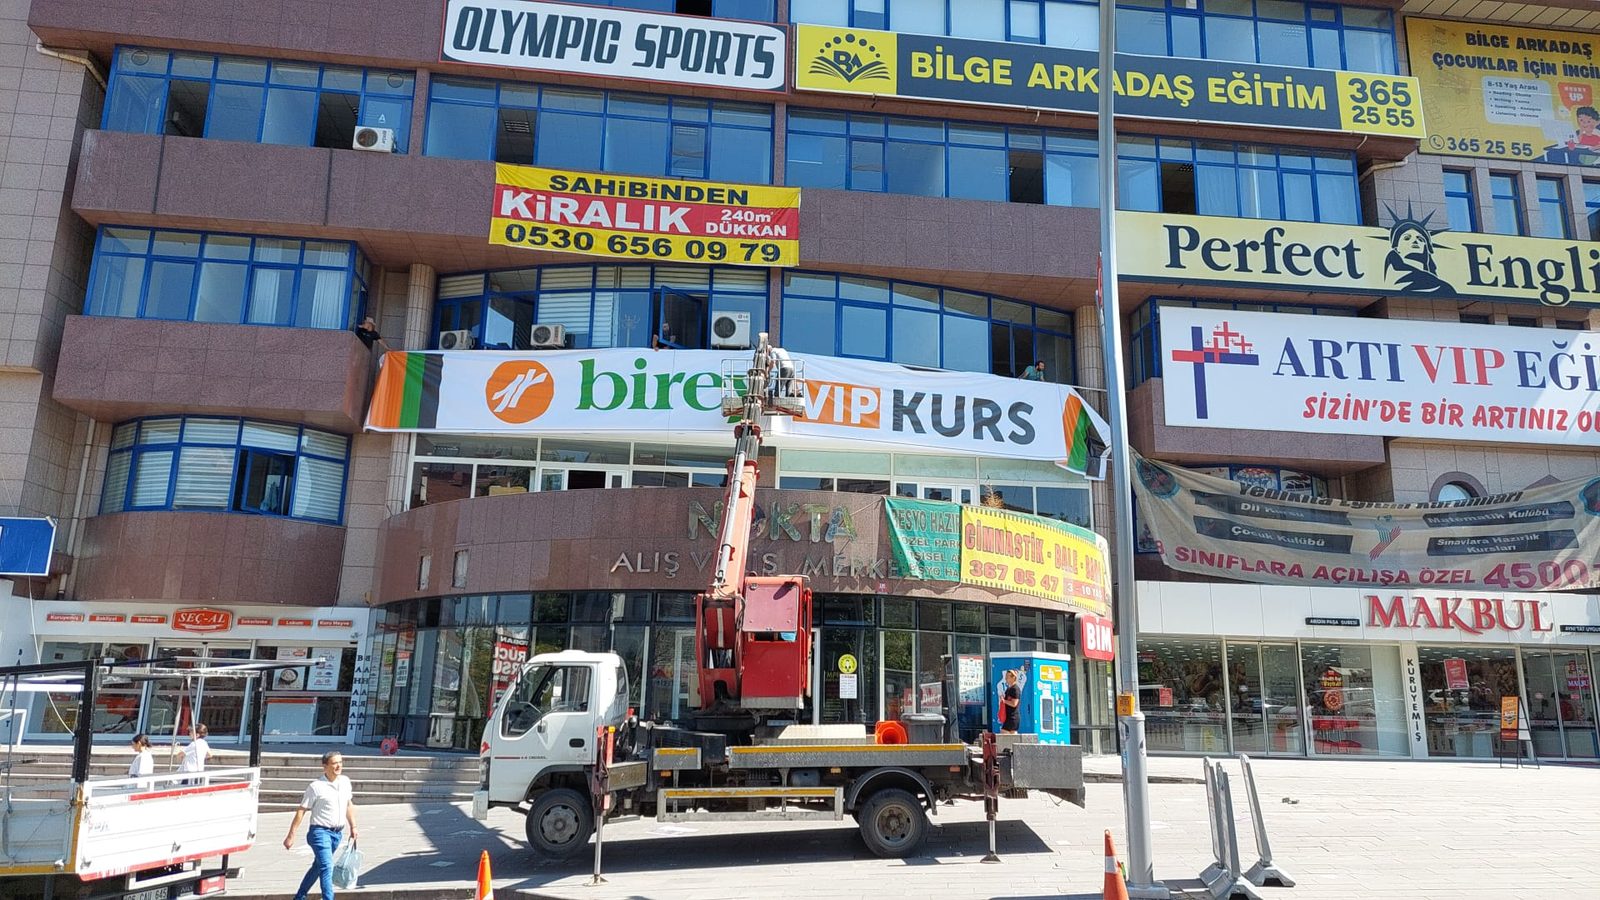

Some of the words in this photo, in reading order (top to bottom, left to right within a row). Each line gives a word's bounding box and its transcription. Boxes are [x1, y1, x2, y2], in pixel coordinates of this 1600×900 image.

[452, 5, 622, 64] OLYMPIC
[632, 23, 778, 78] SPORTS
[1465, 30, 1510, 49] BİLGE
[1516, 37, 1592, 60] ARKADAŞ
[911, 46, 1013, 86] BİLGE
[1027, 62, 1195, 108] ARKADAŞ
[1207, 71, 1327, 111] EĞİTİM
[1432, 52, 1518, 73] ÇOCUKLAR
[1523, 57, 1557, 78] İÇİN
[1348, 77, 1412, 107] 365
[1351, 105, 1381, 124] 25
[1386, 108, 1416, 128] 55
[1447, 137, 1480, 152] 365
[1485, 140, 1506, 154] 25
[1511, 142, 1533, 157] 55
[505, 223, 595, 252] 0530
[607, 233, 673, 259] 656
[685, 239, 728, 261] 09
[739, 242, 782, 263] 79
[706, 220, 787, 237] DÜKKAN
[1163, 223, 1365, 280] Perfect
[1273, 336, 1406, 382] ARTI
[1411, 344, 1506, 387] VIP
[1513, 340, 1600, 392] EĞİ
[803, 383, 880, 425] VIP
[891, 389, 1036, 446] KURS
[1302, 391, 1411, 424] SİZİN'DE
[1420, 398, 1464, 430] BİR
[1471, 405, 1570, 433] ARTINIZ
[1508, 508, 1550, 519] Kulübü
[964, 519, 1045, 565] GİMNASTİK
[1055, 543, 1078, 575] BALE
[1231, 525, 1273, 541] Çocuk
[1276, 533, 1325, 547] Kulübü
[610, 551, 680, 578] ALIŞ
[969, 559, 1008, 581] 367
[1013, 567, 1035, 587] 05
[1040, 574, 1059, 593] 47
[1174, 546, 1304, 578] SINIFLARA
[1312, 565, 1411, 587] AÇILIŞA
[1418, 567, 1475, 585] ÖZEL
[1483, 559, 1589, 590] 4500
[1067, 583, 1073, 592] 3
[1081, 585, 1091, 595] 10
[178, 612, 226, 626] SEÇ-AL
[1364, 595, 1553, 636] MAKBUL
[1086, 618, 1113, 652] BİM
[348, 654, 364, 731] BAHARAT
[1406, 658, 1423, 742] KURUYEMİŞ
